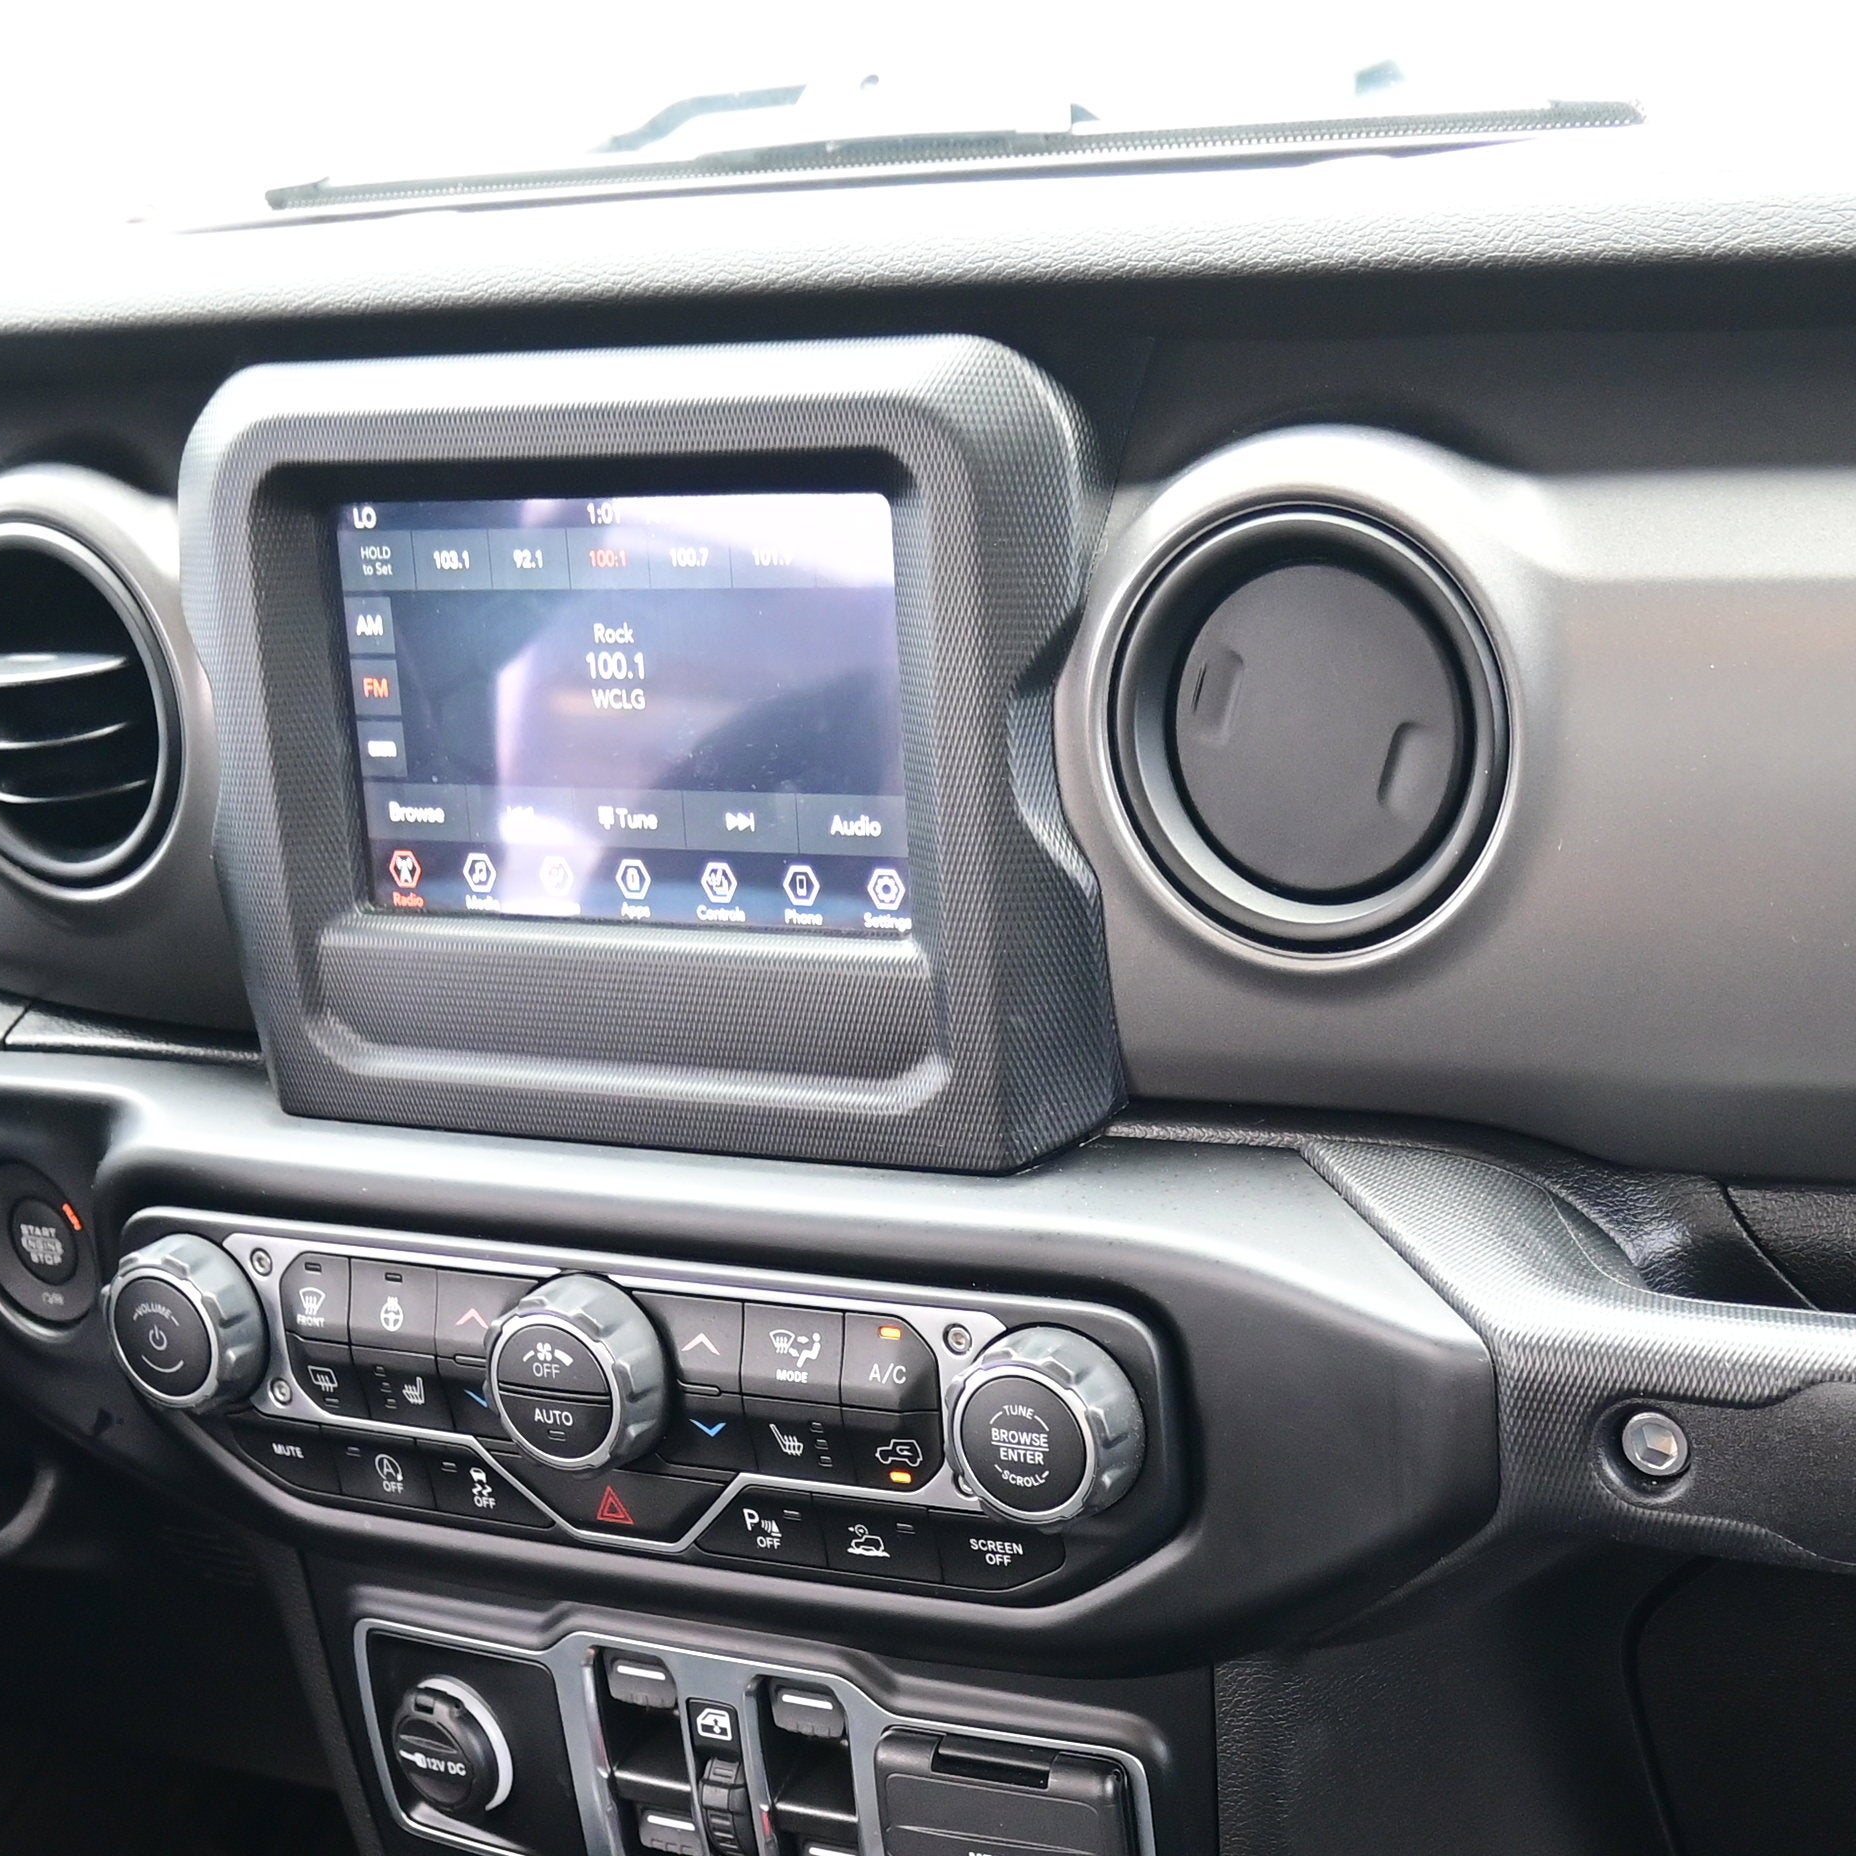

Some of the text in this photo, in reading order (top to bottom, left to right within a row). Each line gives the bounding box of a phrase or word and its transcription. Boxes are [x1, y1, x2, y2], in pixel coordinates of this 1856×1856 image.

[353, 506, 377, 529] LO
[360, 546, 391, 560] HOLD
[513, 549, 543, 569] 92.1
[362, 563, 393, 576] to Set
[356, 615, 383, 636] AM
[593, 622, 634, 644] Rock
[586, 651, 645, 680] 100.1
[363, 678, 389, 698] FM
[592, 688, 646, 710] WCLG
[388, 801, 445, 824] Browse
[615, 808, 658, 830] Tune
[830, 815, 882, 838] Audio
[393, 892, 424, 908] Radio
[696, 905, 746, 924] Controls
[784, 908, 823, 927] Phone
[864, 912, 912, 932] Settings
[136, 1303, 172, 1320] VOLUME
[297, 1314, 326, 1328] FRONT
[532, 1362, 560, 1378] OFF
[776, 1369, 808, 1384] MODE
[868, 1363, 907, 1384] A/C
[534, 1410, 573, 1427] AUTO
[1003, 1405, 1035, 1420] TUNE
[991, 1428, 1049, 1446] BROWSE
[272, 1443, 304, 1459] MUTE
[1000, 1447, 1044, 1465] ENTER
[383, 1480, 404, 1494] OFF
[1001, 1470, 1045, 1487] SCROLL
[473, 1495, 496, 1509] OFF
[757, 1536, 781, 1550] OFF
[970, 1539, 1023, 1556] SCREEN
[986, 1553, 1011, 1567] OFF
[427, 1757, 466, 1776] 12V DC
